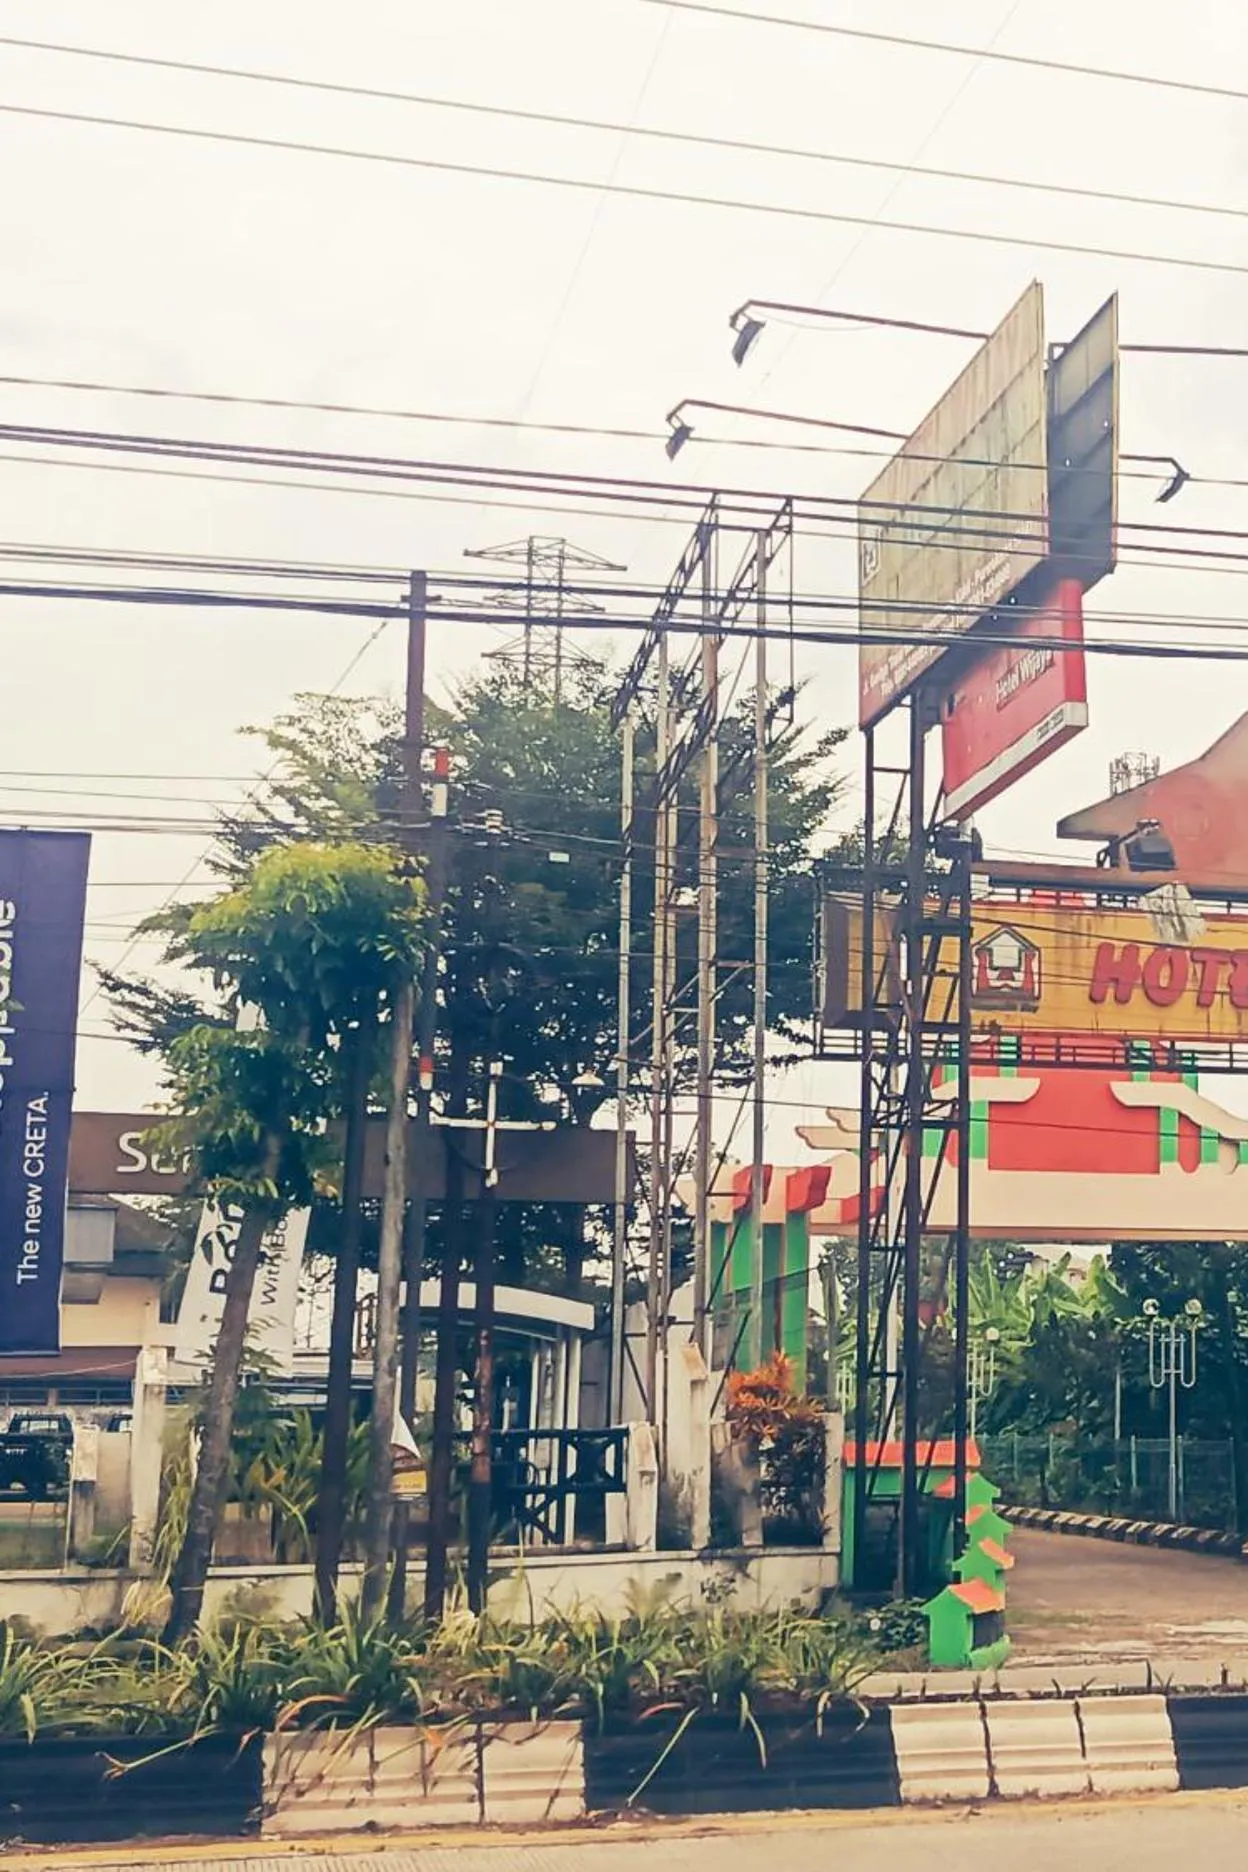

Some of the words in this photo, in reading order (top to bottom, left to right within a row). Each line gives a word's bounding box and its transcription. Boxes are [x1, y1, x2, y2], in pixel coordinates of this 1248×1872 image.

[23, 1091, 49, 1177] CRETA.
[24, 1183, 43, 1233] new
[17, 1240, 40, 1285] The
